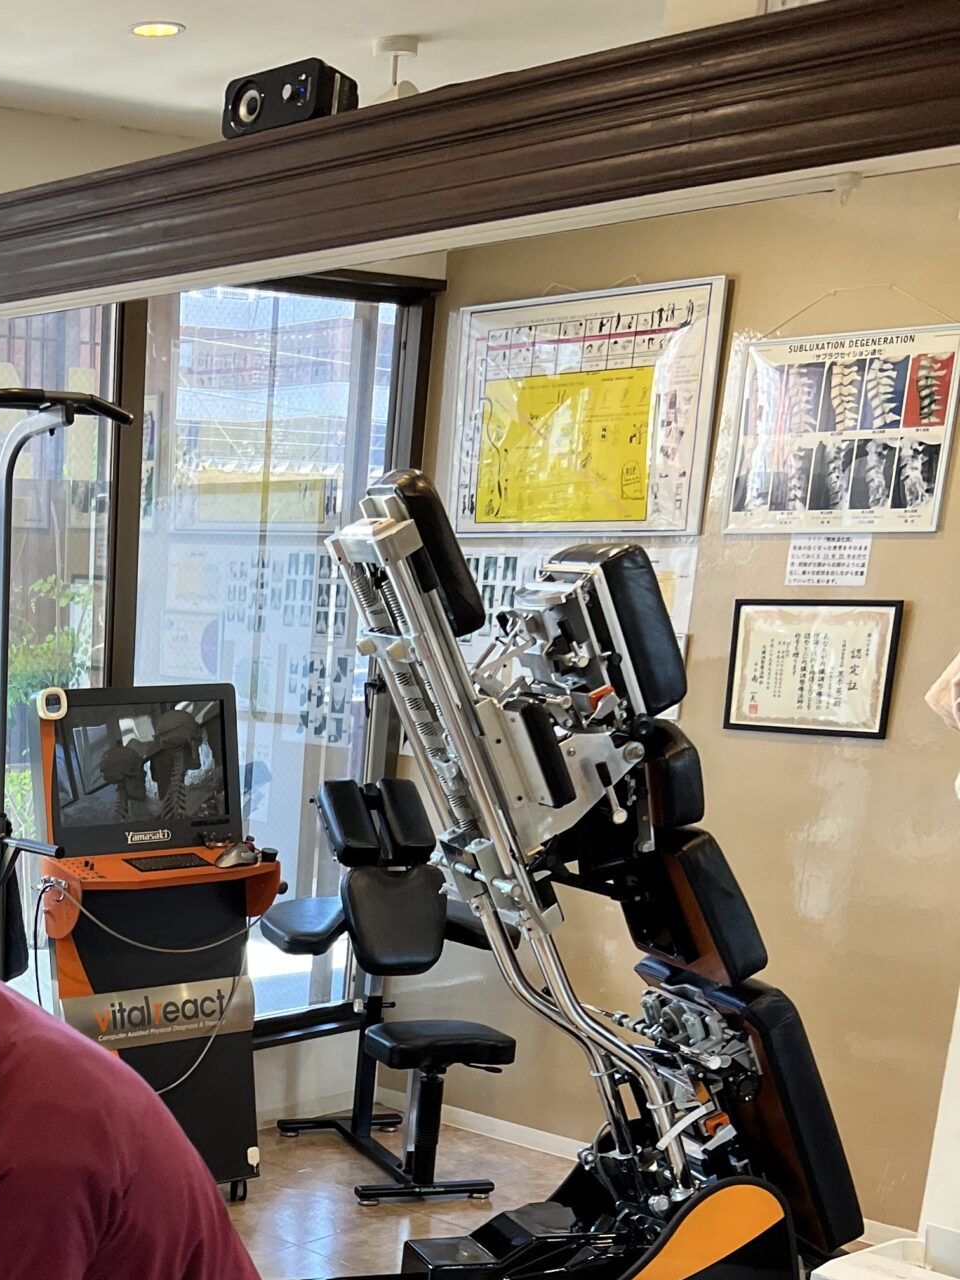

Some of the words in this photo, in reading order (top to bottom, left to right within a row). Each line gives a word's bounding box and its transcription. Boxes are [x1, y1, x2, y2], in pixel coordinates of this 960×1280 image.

[788, 340, 845, 354] SUBLUXATION
[848, 334, 916, 348] DEGENERATION
[125, 829, 170, 844] Yamasaki
